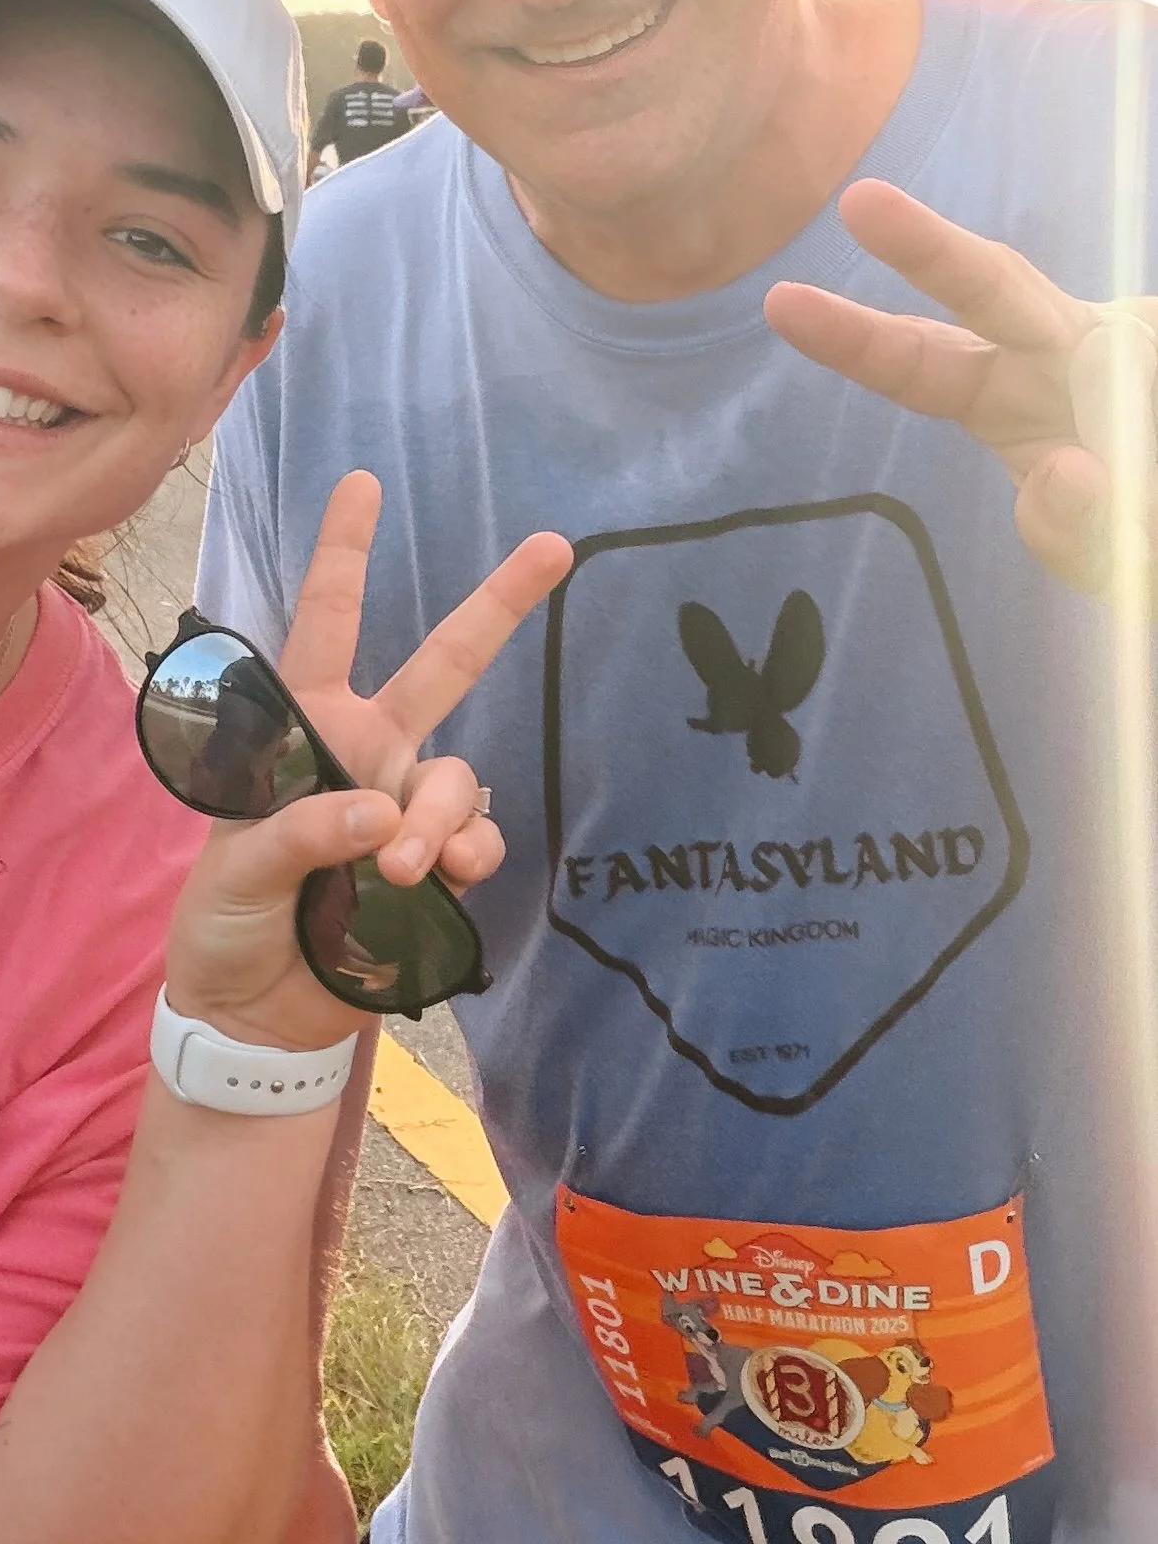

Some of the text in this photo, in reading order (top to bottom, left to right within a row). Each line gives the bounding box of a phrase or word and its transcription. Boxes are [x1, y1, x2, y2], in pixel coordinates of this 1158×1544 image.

[748, 919, 860, 948] KINGDOM
[749, 1245, 816, 1277] Disney
[968, 1239, 1011, 1295] D
[721, 1304, 910, 1335] HALF MARATHON 2025
[579, 1273, 647, 1407] 11801
